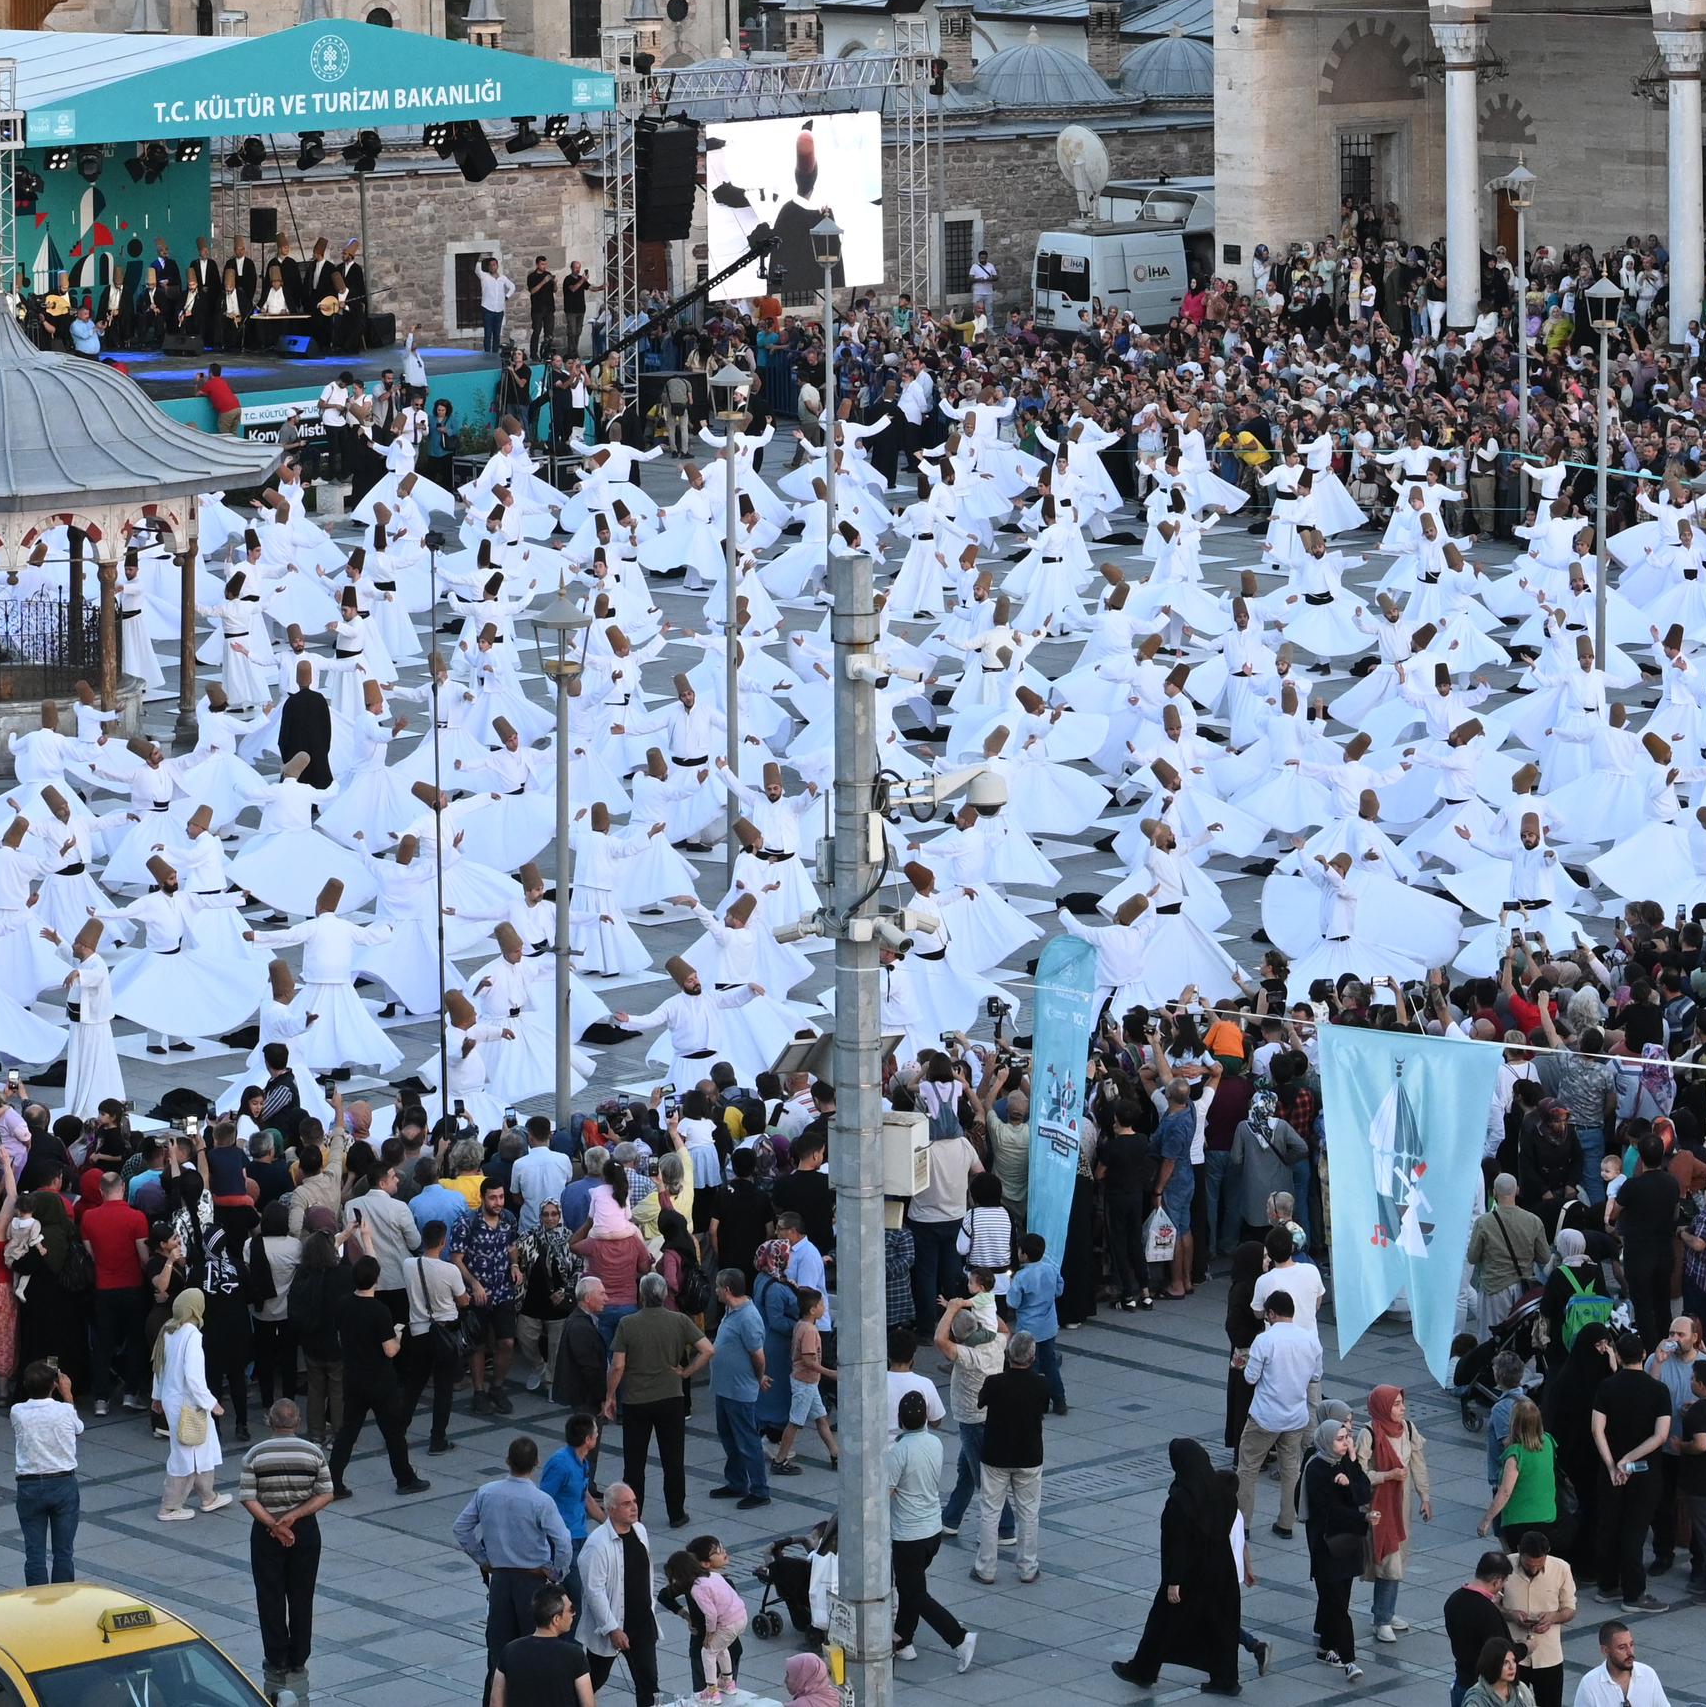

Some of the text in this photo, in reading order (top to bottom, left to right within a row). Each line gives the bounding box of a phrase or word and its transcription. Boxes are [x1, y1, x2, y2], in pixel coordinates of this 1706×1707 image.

[154, 77, 502, 123] T.C. KÜLTÜR VE TURİZM BAKANLIĞI
[248, 423, 327, 443] Kony Misti
